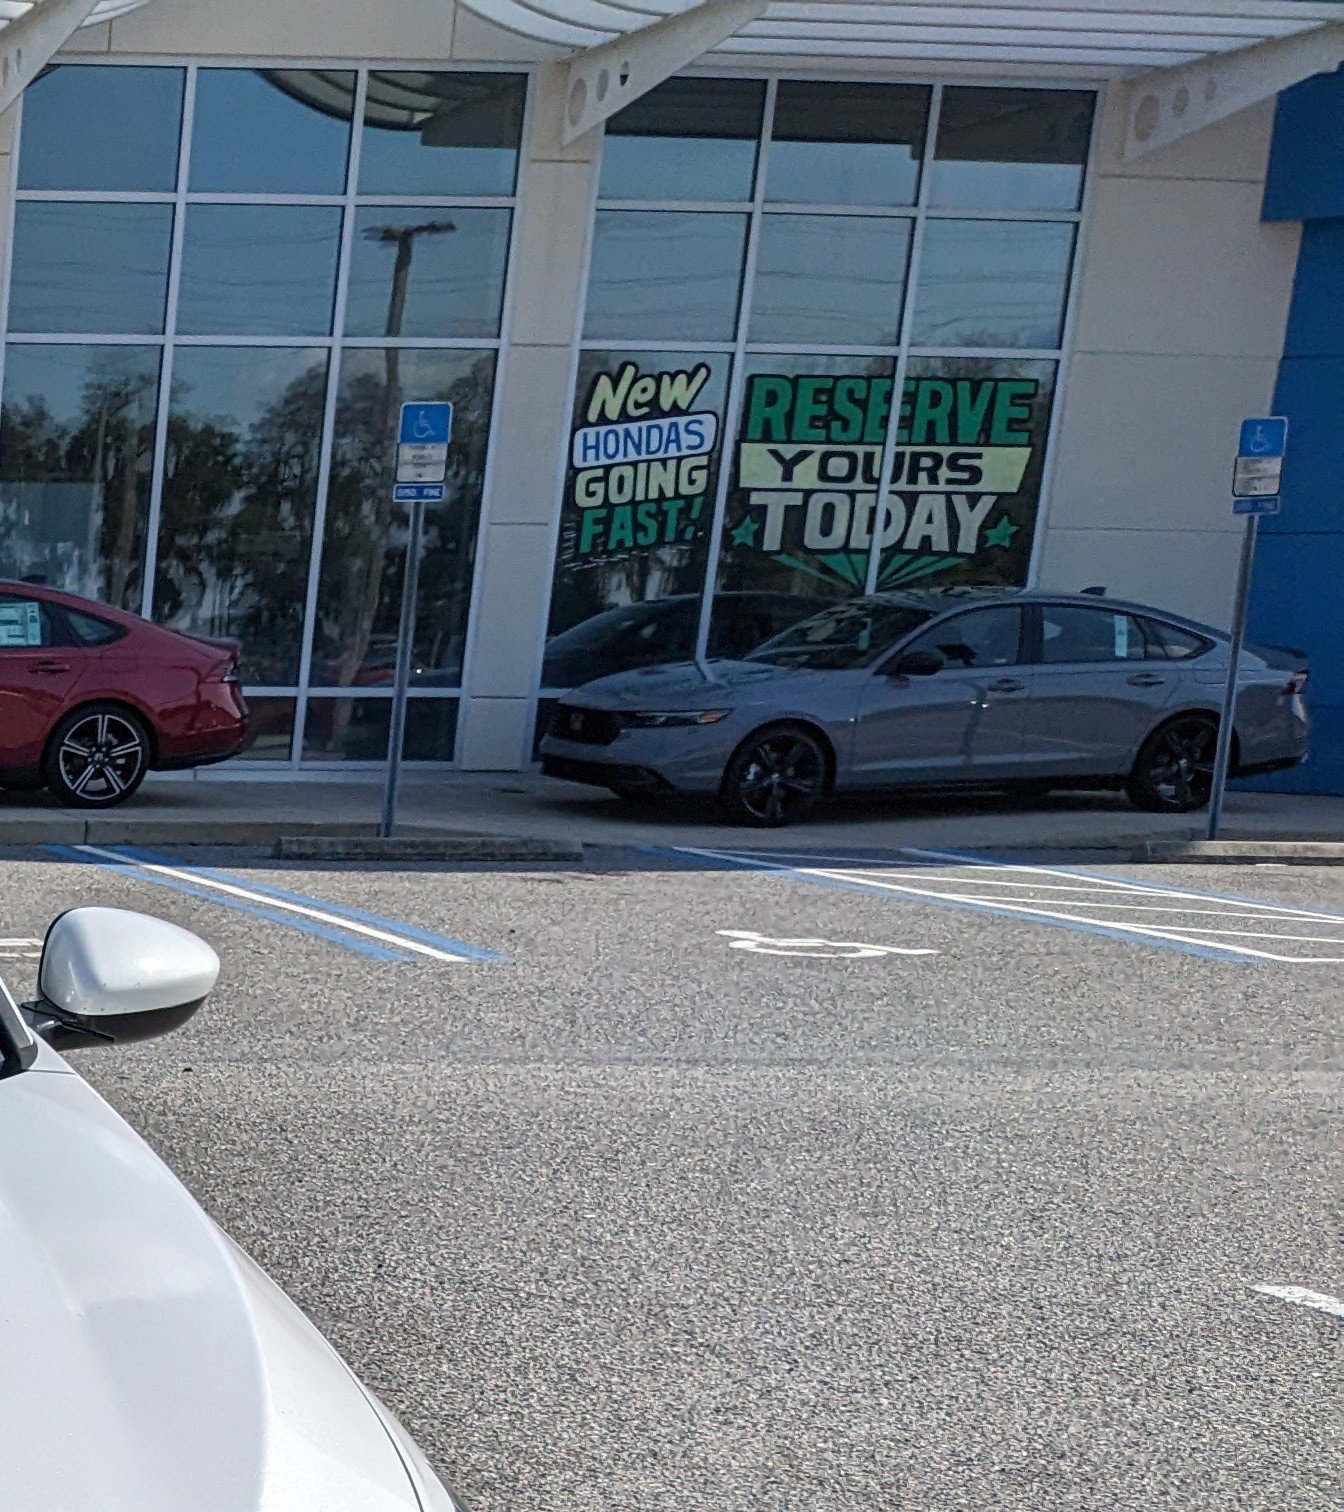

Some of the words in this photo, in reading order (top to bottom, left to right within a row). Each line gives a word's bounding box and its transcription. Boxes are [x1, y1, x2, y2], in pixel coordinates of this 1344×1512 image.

[586, 363, 709, 424] New
[746, 377, 1037, 445] RESERVE
[581, 418, 706, 464] HONDAS
[765, 448, 984, 487] YOURS
[574, 454, 710, 508] GOING
[578, 495, 705, 554] FAST!
[749, 490, 999, 554] TODAY
